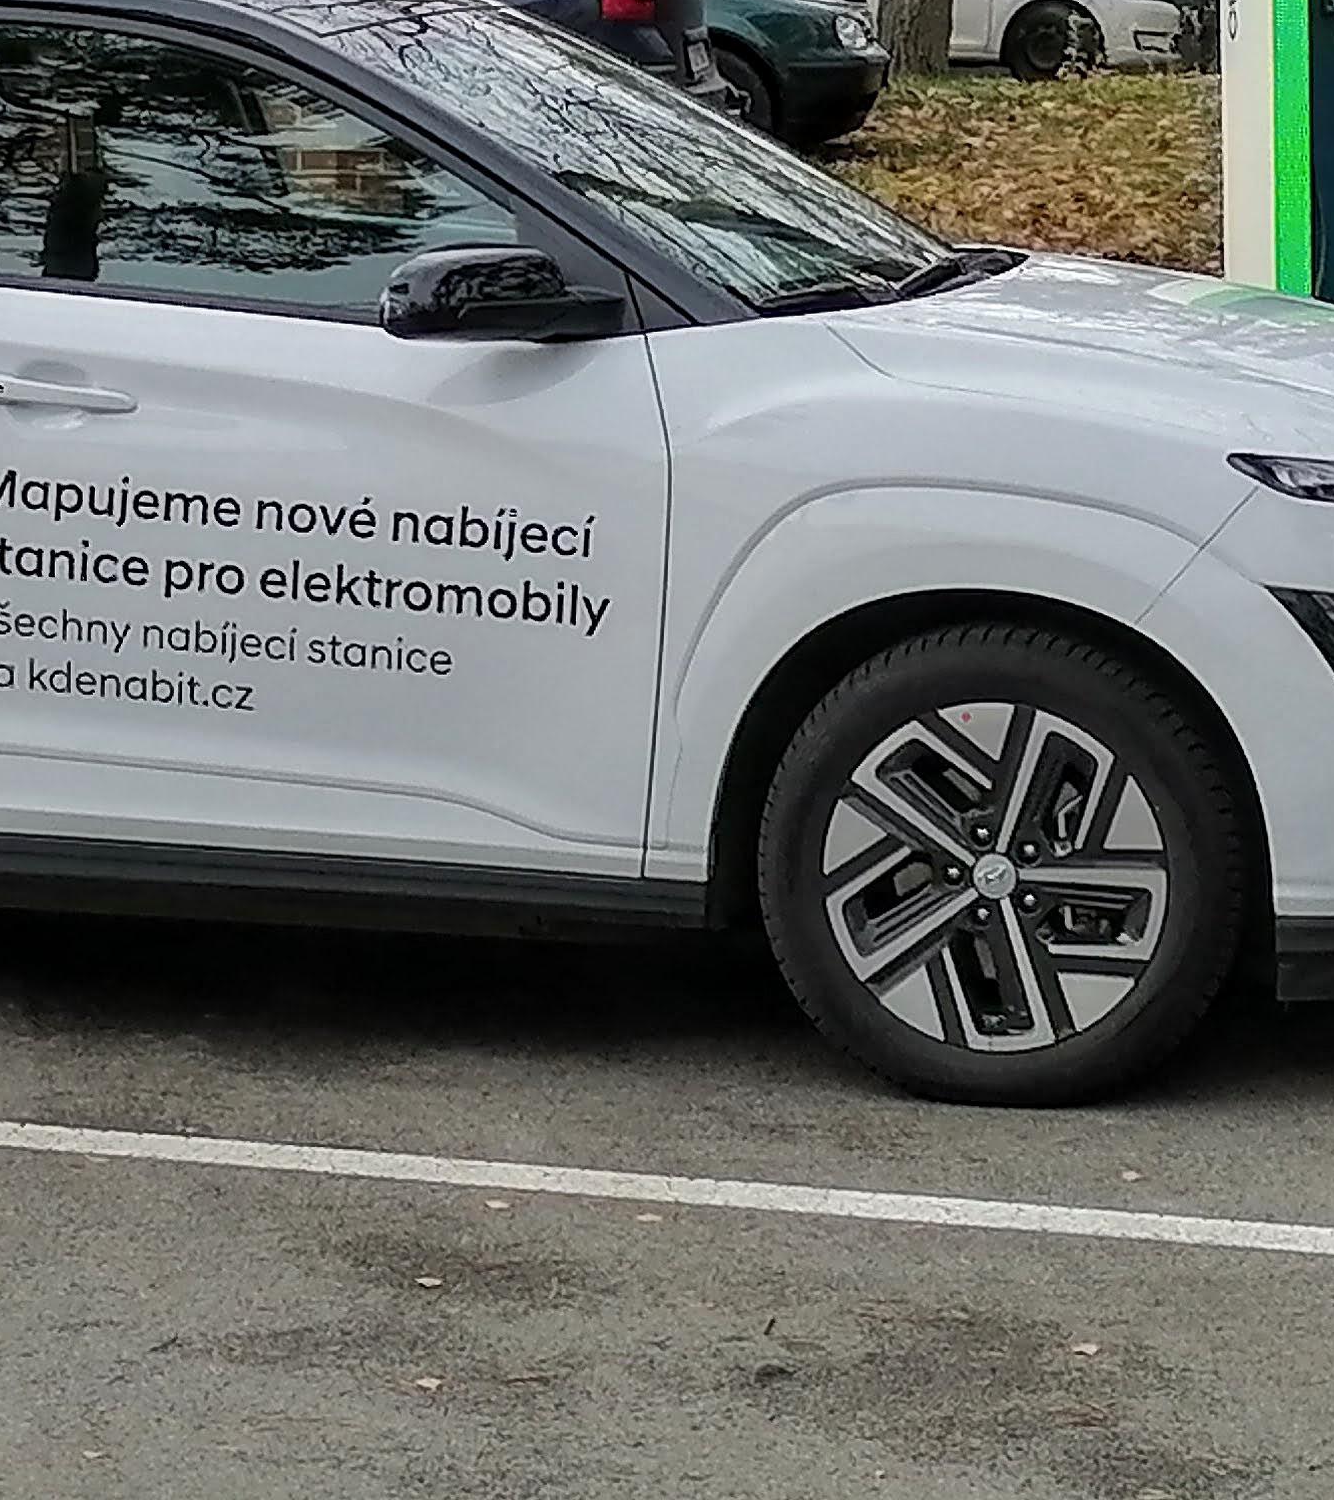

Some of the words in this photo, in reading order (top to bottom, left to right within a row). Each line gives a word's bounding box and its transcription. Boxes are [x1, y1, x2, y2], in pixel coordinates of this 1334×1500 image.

[256, 497, 377, 538] nové
[392, 505, 596, 561] nabíjecí
[163, 559, 245, 598] pro
[260, 559, 611, 636] elektromobily
[29, 658, 255, 711] kdenabit.cz
[307, 636, 453, 675] stanice
